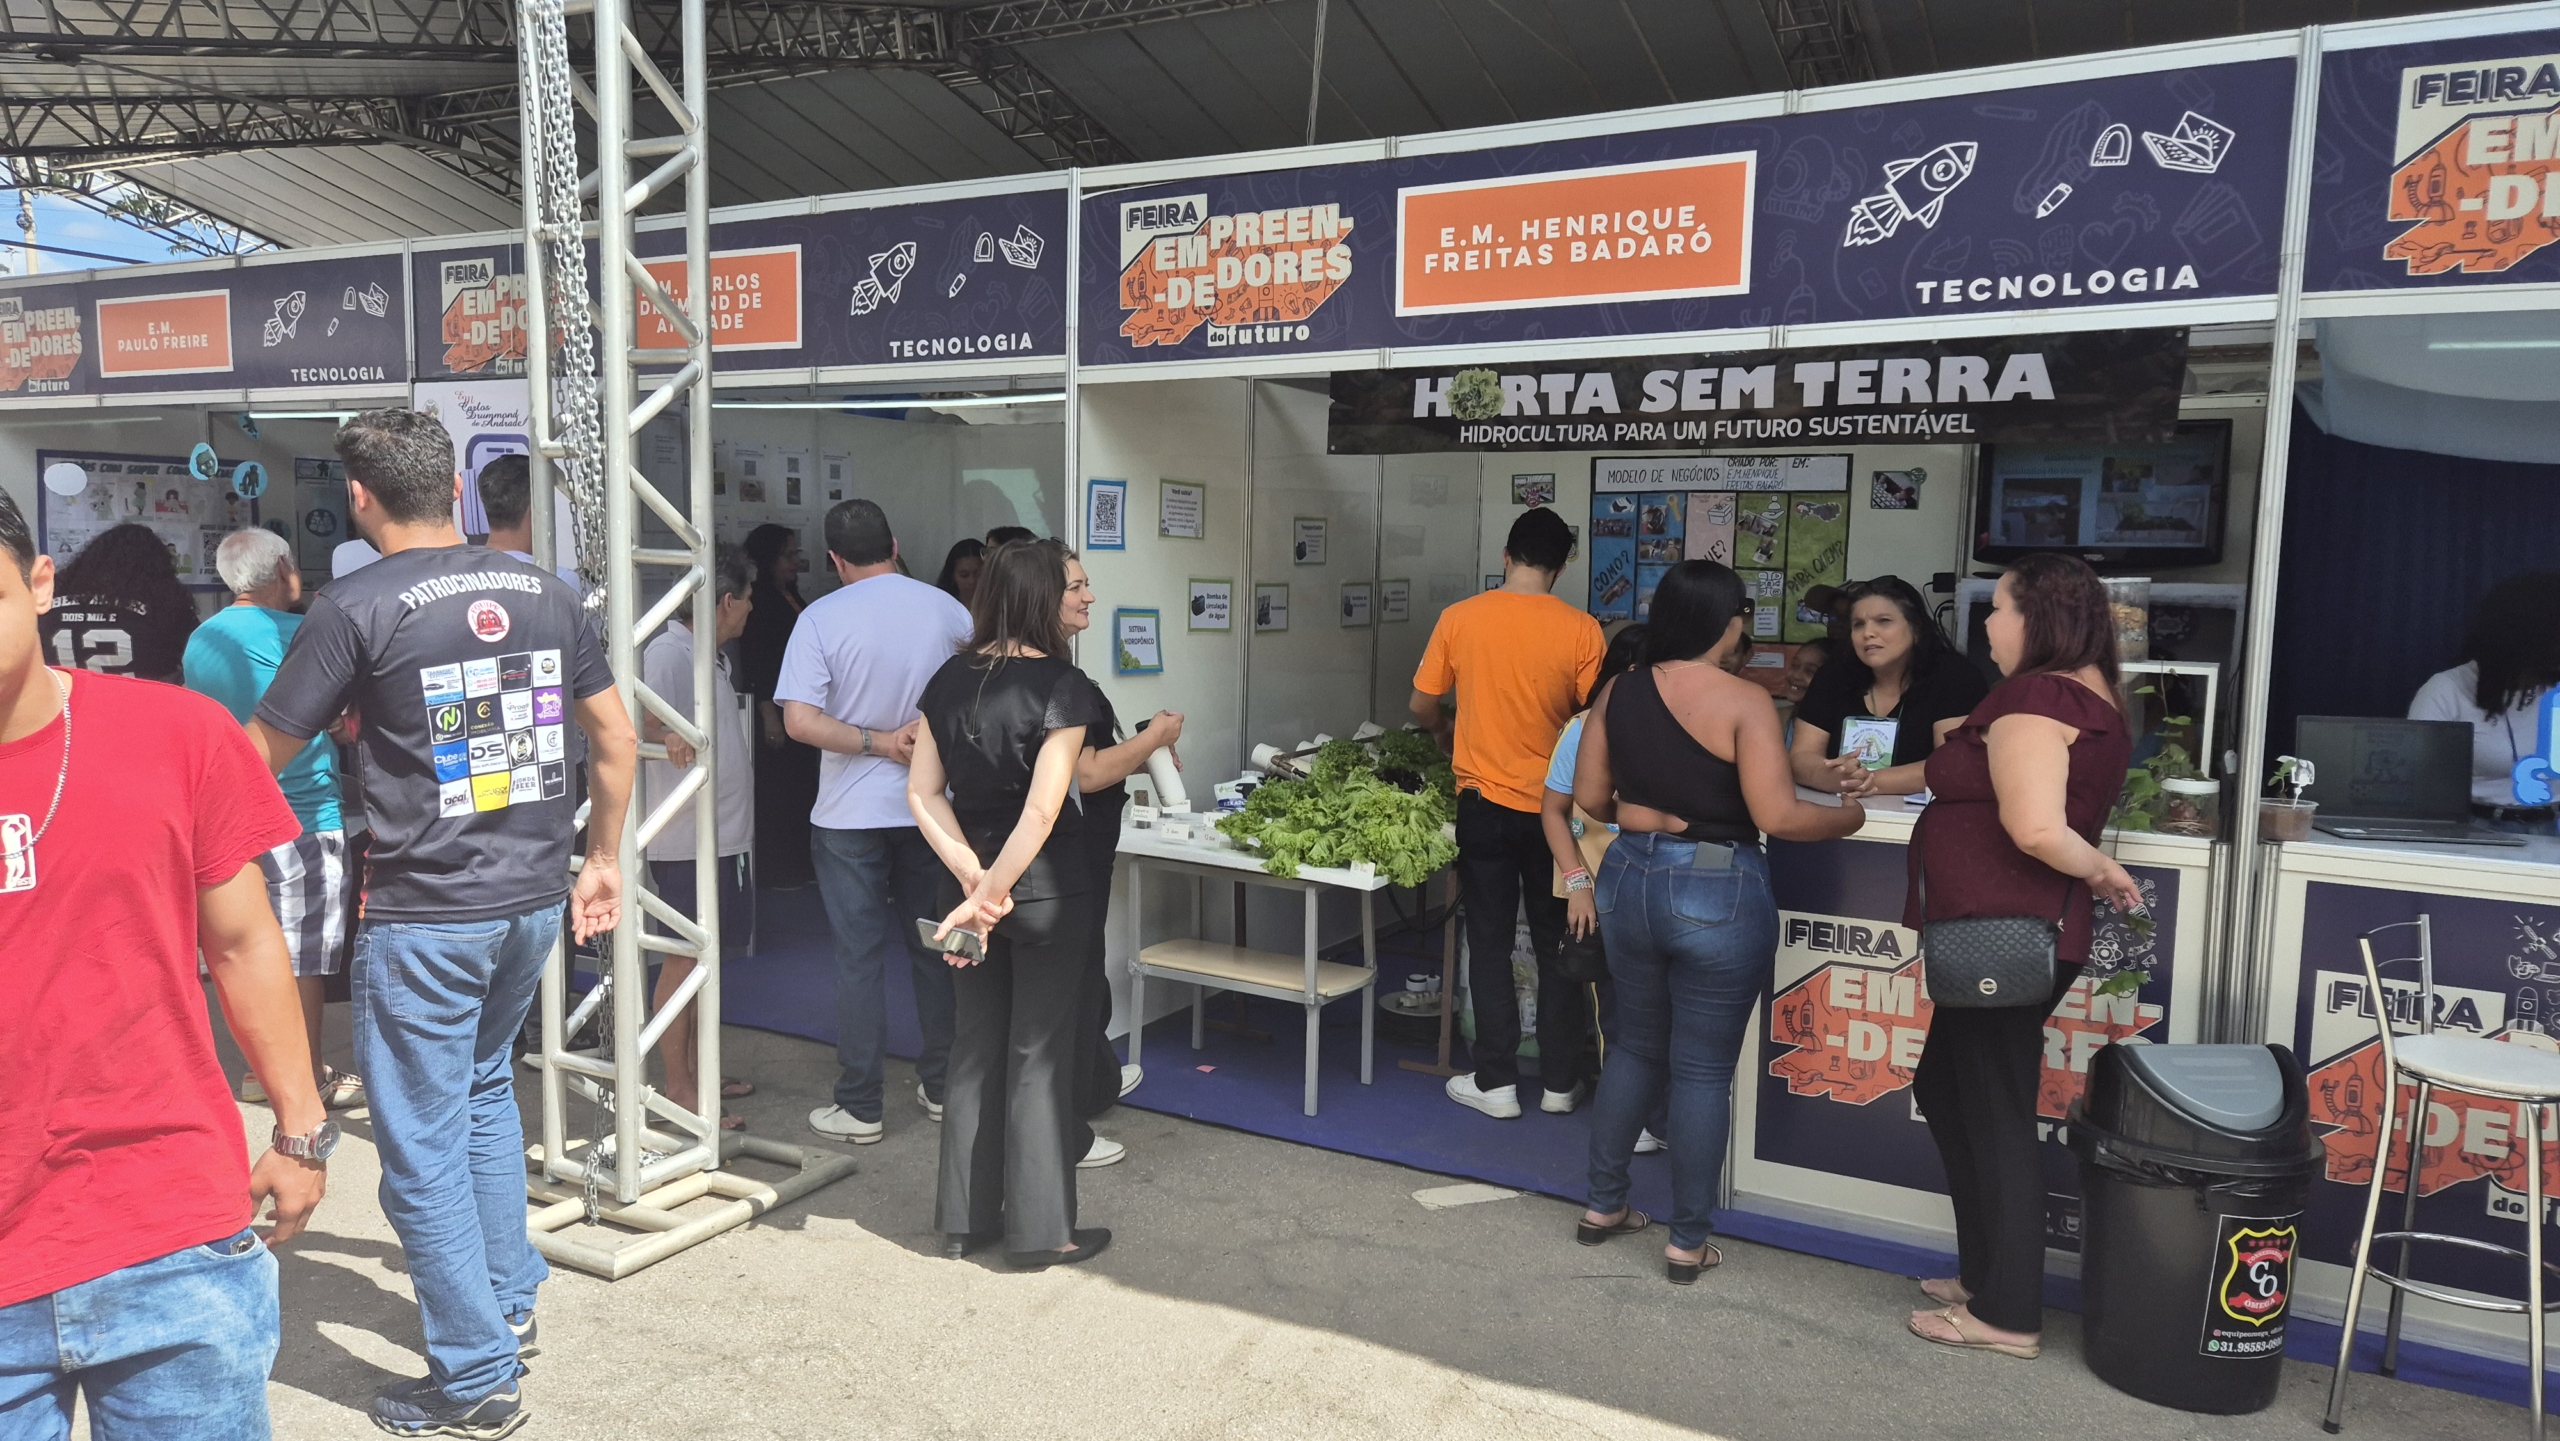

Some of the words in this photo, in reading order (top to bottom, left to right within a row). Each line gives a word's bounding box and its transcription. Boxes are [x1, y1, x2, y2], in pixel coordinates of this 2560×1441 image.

[2412, 62, 2560, 110] FEIRA
[1126, 200, 1199, 231] FEIRA
[1441, 223, 1505, 248] E.M.
[1521, 205, 1696, 240] HENRIQUE
[1425, 244, 1554, 274] FREITAS
[1570, 223, 1712, 263] BADARÓ
[445, 262, 490, 285] FEIRA
[1915, 264, 2199, 304] TECNOLOGIA
[738, 292, 762, 309] DE
[148, 321, 175, 335] E.M.
[1210, 332, 1225, 343] do
[1227, 324, 1310, 346] futuro
[118, 337, 159, 352] PAULO
[163, 334, 209, 349] FREIRE
[889, 332, 1033, 358] TECNOLOGIA
[291, 365, 386, 382] TECNOLOGIA
[1639, 364, 1776, 413] SEM
[1794, 353, 2056, 407] TERRA
[38, 380, 70, 392] futuro
[458, 401, 491, 413] Carlos
[466, 409, 520, 420] Drummond
[1460, 423, 1608, 444] HIDROCULTURA
[1614, 422, 1667, 442] PARA
[1673, 420, 1707, 441] UM
[1713, 417, 1802, 439] FUTURO
[1808, 409, 1975, 436] SUSTENTÁVEL
[1727, 457, 1756, 468] CRIADO
[1607, 469, 1647, 483] MODELO
[1651, 469, 1665, 483] DE
[1671, 465, 1720, 482] NEGÓCIOS
[1726, 480, 1754, 490] FREITAS
[1593, 550, 1632, 593] COMO?
[1787, 570, 1815, 597] PARA
[1812, 540, 1846, 574] QUEM?
[398, 571, 543, 610] PATROCINADORES
[61, 612, 85, 622] DOIS
[87, 613, 107, 622] MIL
[470, 743, 506, 761] DS
[1785, 918, 1903, 961] FEIRA
[2492, 1196, 2525, 1215] do
